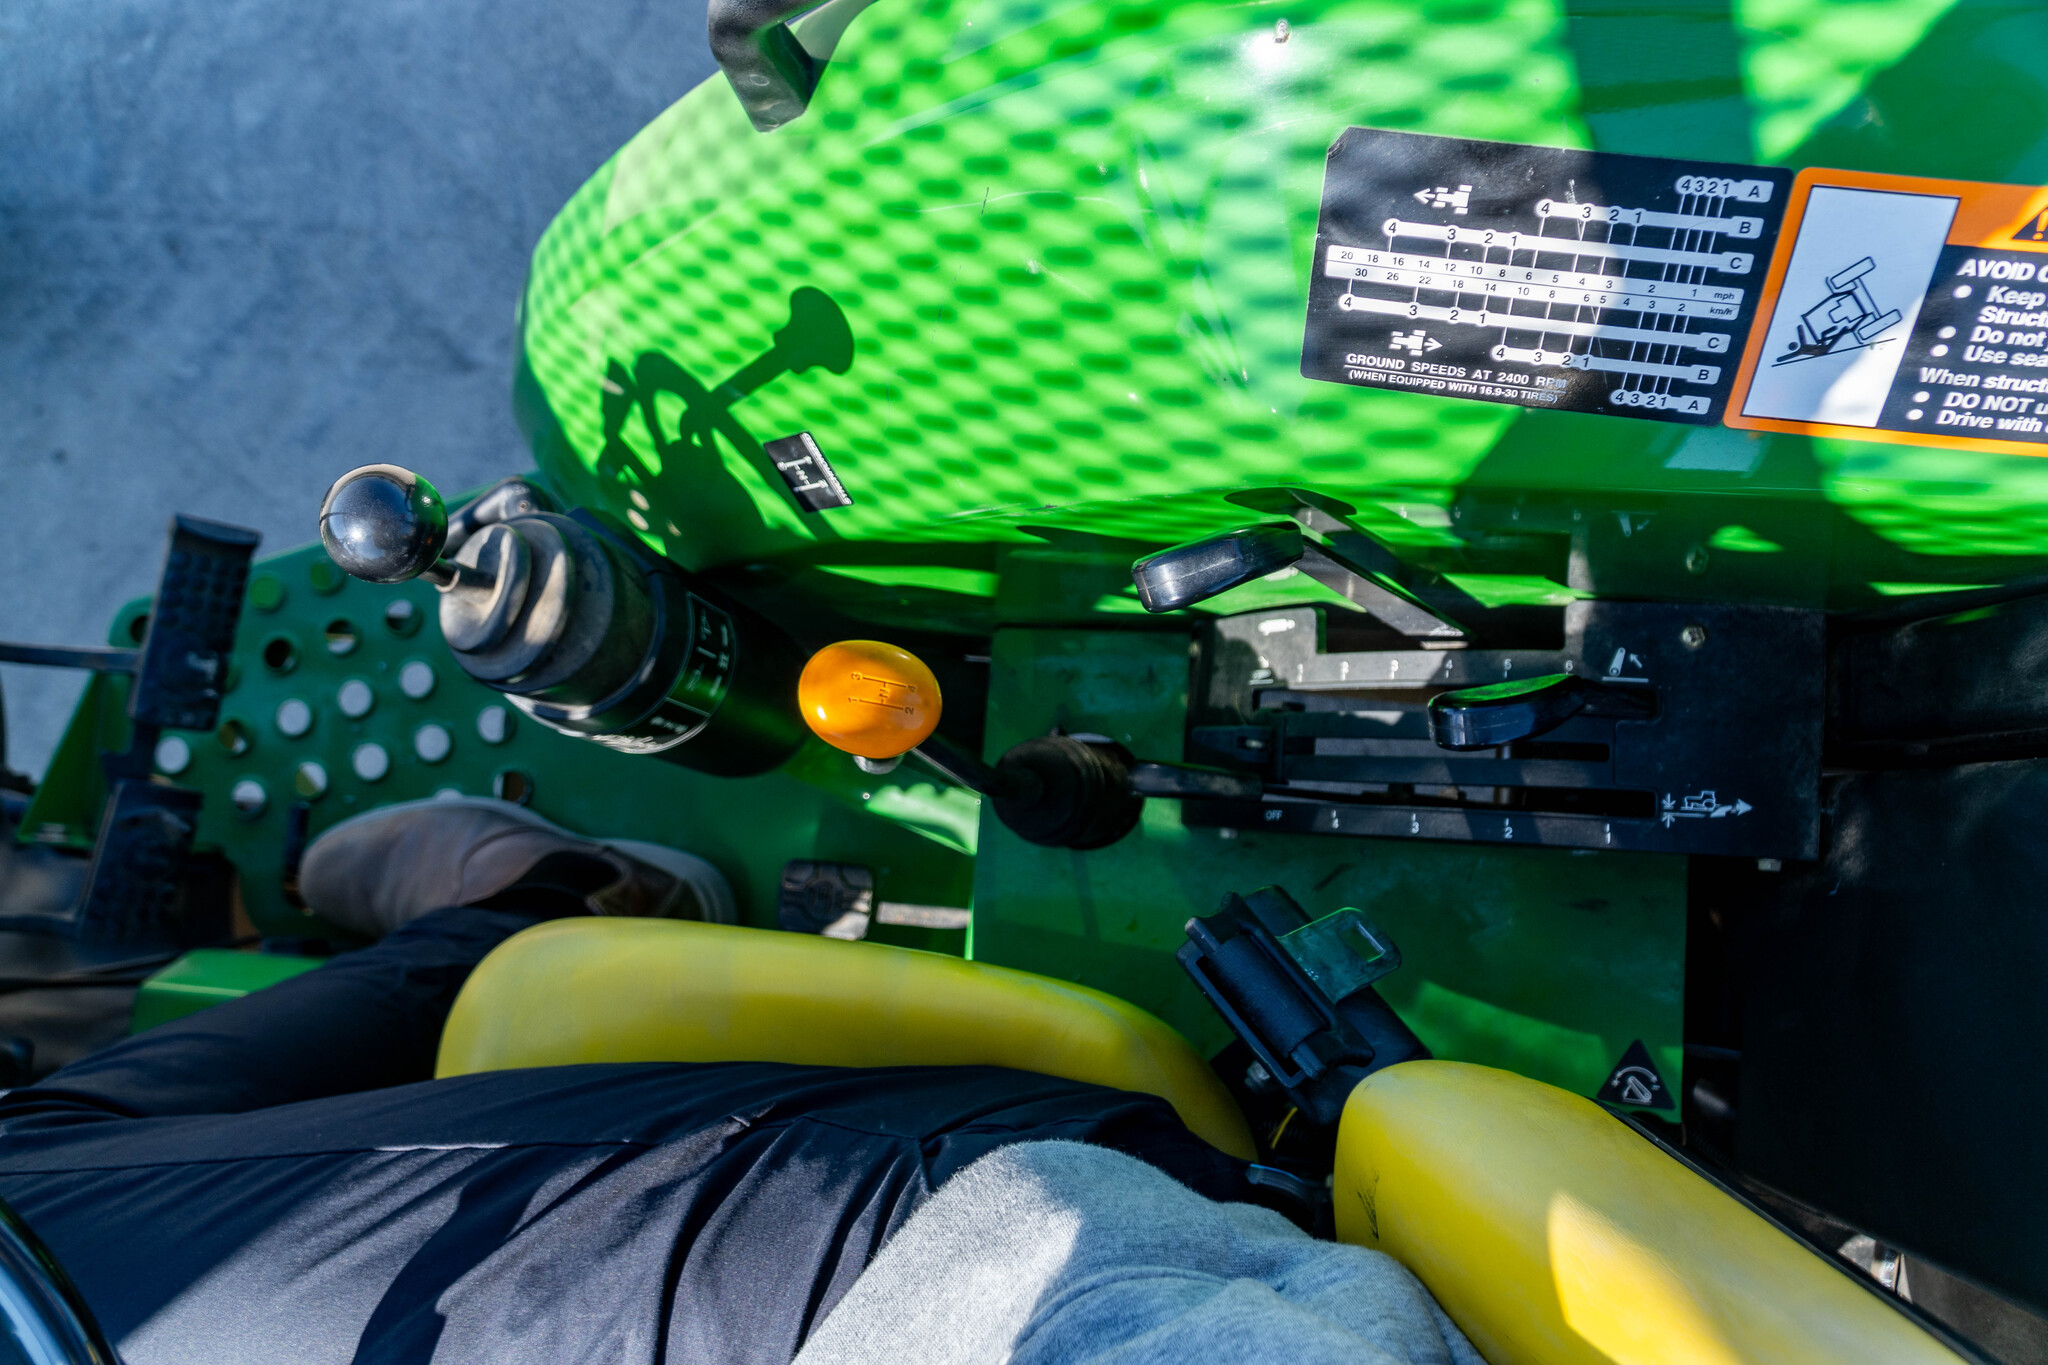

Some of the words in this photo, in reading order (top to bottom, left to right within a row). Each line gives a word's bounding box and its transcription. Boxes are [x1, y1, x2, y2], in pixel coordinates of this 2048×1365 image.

[1681, 178, 1691, 191] 4
[1695, 180, 1705, 192] 3
[1708, 181, 1718, 193] 2
[1722, 182, 1729, 194] 1
[1748, 185, 1761, 198] A
[1541, 203, 1550, 214] 4
[1582, 206, 1591, 218] 3
[1609, 210, 1619, 222] 2
[1635, 212, 1642, 223] 1
[1739, 222, 1751, 234] B
[1388, 223, 1397, 234] 4
[1447, 228, 1456, 240] 3
[1484, 232, 1494, 244] 2
[1511, 235, 1518, 246] 1
[1730, 257, 1743, 269] C
[1341, 251, 1354, 260] 20
[1367, 254, 1379, 263] 18
[1393, 257, 1404, 266] 16
[1418, 260, 1430, 269] 14
[1445, 263, 1456, 272] 12
[1471, 265, 1483, 275] 10
[1499, 268, 1506, 278] 8
[1525, 271, 1533, 281] 6
[1552, 274, 1560, 283] 5
[1579, 277, 1586, 286] 4
[1606, 280, 1613, 289] 3
[1648, 284, 1656, 293] 2
[1692, 288, 1697, 297] 1
[1714, 291, 1735, 301] mph
[1957, 259, 2036, 281] AVOID
[1355, 268, 1368, 278] 30
[1387, 271, 1399, 281] 26
[1419, 275, 1431, 285] 22
[1452, 279, 1464, 289] 18
[1485, 283, 1496, 292] 14
[1518, 286, 1530, 296] 10
[1549, 290, 1556, 299] 8
[1583, 293, 1590, 302] 6
[1600, 295, 1607, 304] 5
[1623, 298, 1630, 306] 4
[1649, 300, 1656, 309] 3
[1678, 303, 1686, 312] 2
[1986, 285, 2047, 310] Keep
[1344, 297, 1352, 307] 4
[1409, 304, 1418, 316] 3
[1450, 309, 1459, 321] 2
[1480, 312, 1486, 323] 1
[1707, 337, 1720, 349] C
[1969, 326, 2005, 344] Do
[2006, 330, 2047, 348] not
[1496, 347, 1505, 358] 4
[1534, 351, 1543, 363] 3
[1562, 355, 1571, 366] 2
[1583, 357, 1589, 368] 1
[1698, 369, 1710, 381] B
[1962, 345, 2009, 364] Use
[1346, 353, 1405, 370] GROUND
[1411, 361, 1466, 378] SPEEDS
[1472, 369, 1492, 380] AT
[1496, 372, 1529, 385] 2400
[1535, 376, 1568, 389] RPM
[1919, 367, 1981, 388] When
[1349, 369, 1387, 383] (WHEN
[1389, 374, 1446, 390] EQUIPPED
[1449, 381, 1478, 394] WITH
[1480, 385, 1518, 398] 16.9-30
[1520, 390, 1558, 403] TIRES)
[1615, 391, 1624, 402] 4
[1630, 393, 1639, 404] 3
[1646, 395, 1656, 406] 2
[1660, 396, 1667, 407] 1
[1688, 400, 1700, 411] A
[1943, 392, 1981, 409] DO
[1981, 395, 2036, 414] NOT
[1935, 409, 1994, 429] Drive
[1995, 415, 2044, 433] with
[796, 470, 808, 481] N
[1446, 659, 1454, 670] 4
[1504, 658, 1512, 670] 5
[1565, 660, 1573, 671] 6
[851, 672, 862, 681] 3
[908, 685, 917, 693] 4
[879, 687, 890, 699] N
[905, 706, 914, 715] 2
[1264, 809, 1283, 821] OFF
[1332, 818, 1339, 829] 4
[1411, 821, 1420, 834] 3
[1504, 826, 1513, 839] 2
